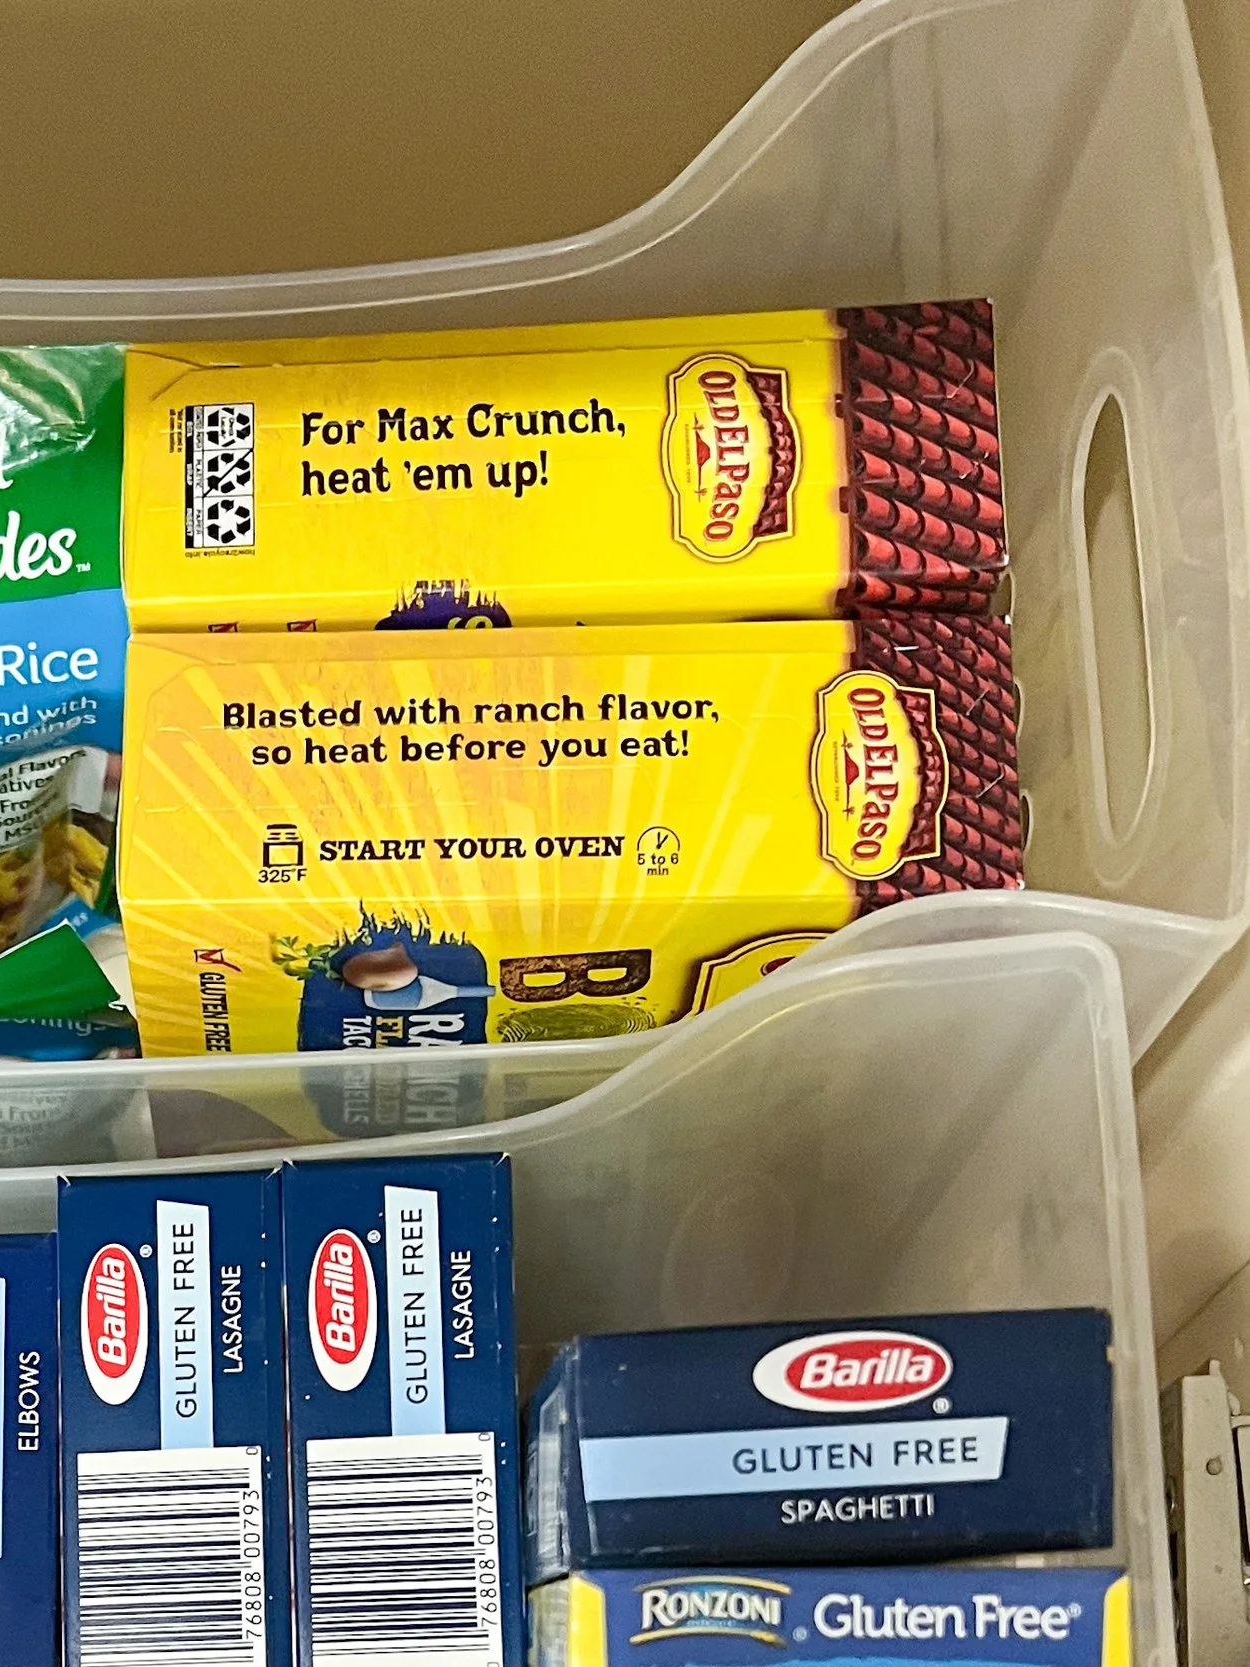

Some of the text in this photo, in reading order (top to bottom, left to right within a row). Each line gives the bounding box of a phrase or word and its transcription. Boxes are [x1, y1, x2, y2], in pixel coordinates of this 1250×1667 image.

[302, 398, 627, 448] For Max Crunch,
[302, 457, 392, 498] heat
[486, 451, 549, 493] up!
[36, 696, 97, 722] with
[223, 691, 720, 731] Blasted with ranch flavor,
[251, 727, 691, 768] so heat before you eat!
[319, 836, 625, 862] START YOUR OVEN
[199, 972, 231, 1052] GLUTEN FREE
[95, 1256, 127, 1366] Barilla
[172, 1223, 197, 1418] GLUTEN FREE
[221, 1265, 244, 1374] LASAGNE
[323, 1242, 356, 1352] Barilla
[401, 1208, 428, 1404] GLUTEN FREE
[451, 1251, 474, 1359] LASAGNE
[800, 1350, 935, 1390] Barilla
[18, 1351, 41, 1452] ELBOWS
[732, 1435, 979, 1477] GLUTEN FREE
[780, 1494, 934, 1526] SPAGHETTI
[243, 1490, 262, 1640] 76808 00793
[476, 1476, 498, 1628] 76808 00793
[640, 1589, 782, 1630] RONZONI
[813, 1594, 1070, 1640] Gluten Free
